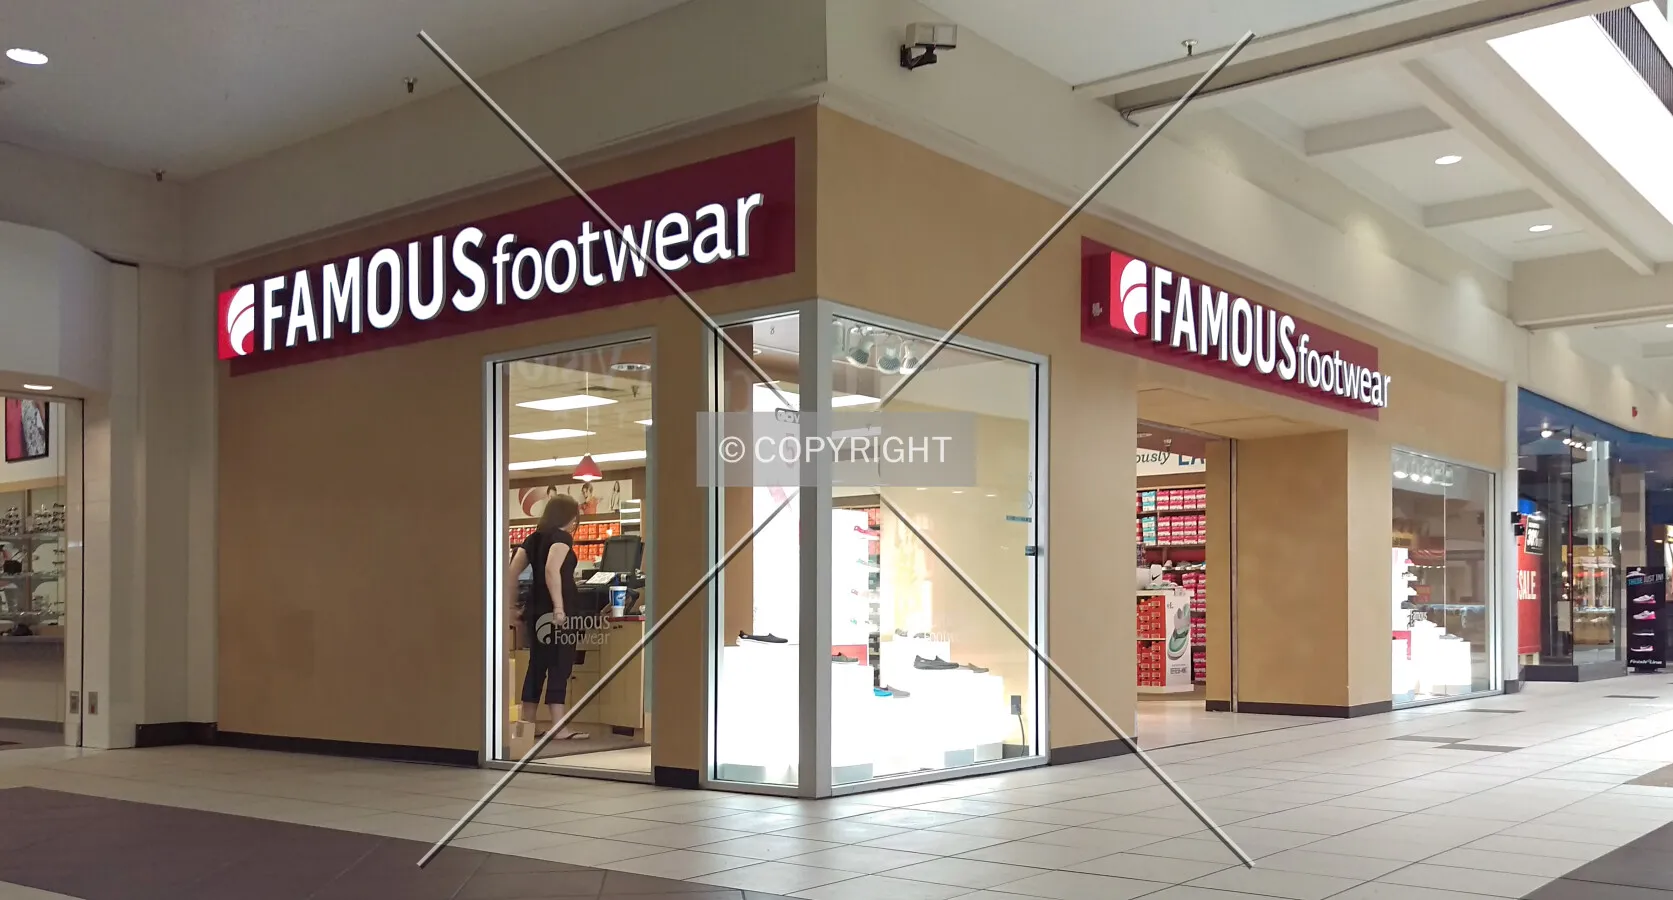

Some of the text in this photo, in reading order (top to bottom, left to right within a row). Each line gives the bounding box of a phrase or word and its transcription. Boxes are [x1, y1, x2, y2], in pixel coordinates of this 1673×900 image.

[263, 192, 764, 351] FAMOUS footwear
[1152, 266, 1391, 408] FAMOUS footwear
[1518, 570, 1537, 600] SALE
[554, 630, 611, 645] Footwear
